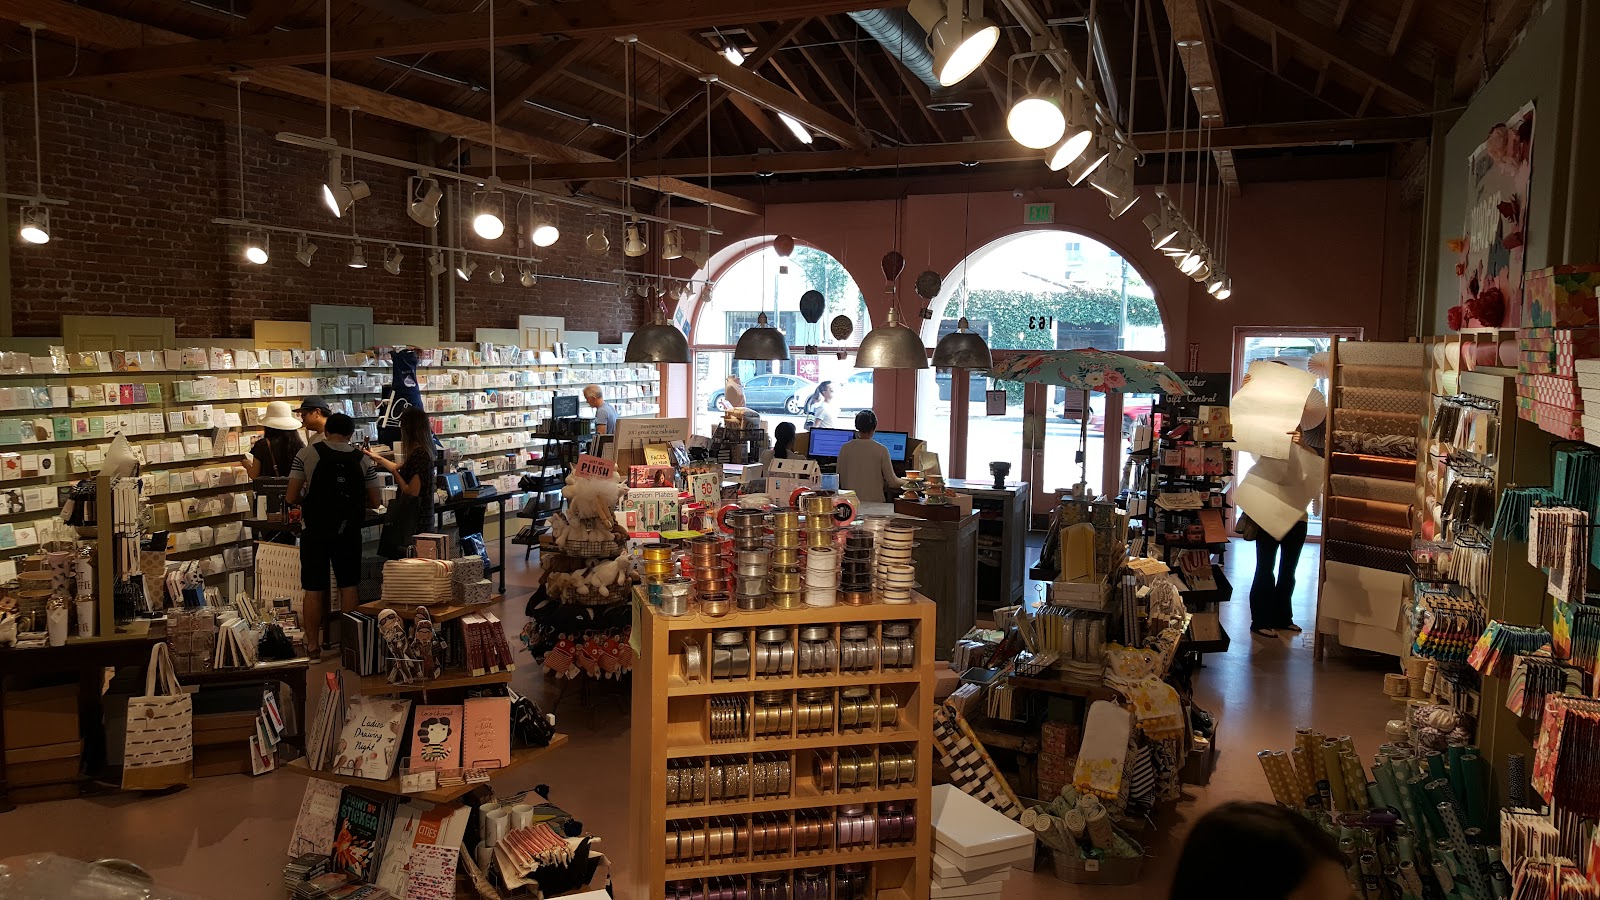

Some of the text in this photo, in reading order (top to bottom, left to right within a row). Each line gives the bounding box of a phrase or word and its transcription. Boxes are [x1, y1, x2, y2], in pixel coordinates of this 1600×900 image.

[1029, 206, 1050, 221] EXIT
[1184, 375, 1207, 387] acher
[1187, 392, 1218, 403] Central
[581, 463, 610, 477] PLUSH
[629, 491, 675, 500] Fashion Plates
[702, 483, 714, 495] 50
[362, 716, 386, 728] Ladies
[354, 728, 383, 743] Drawing
[355, 741, 377, 754] Night
[347, 795, 368, 812] PAINT
[367, 803, 377, 814] BY
[341, 804, 378, 831] STICKER
[418, 825, 438, 839] CITIES
